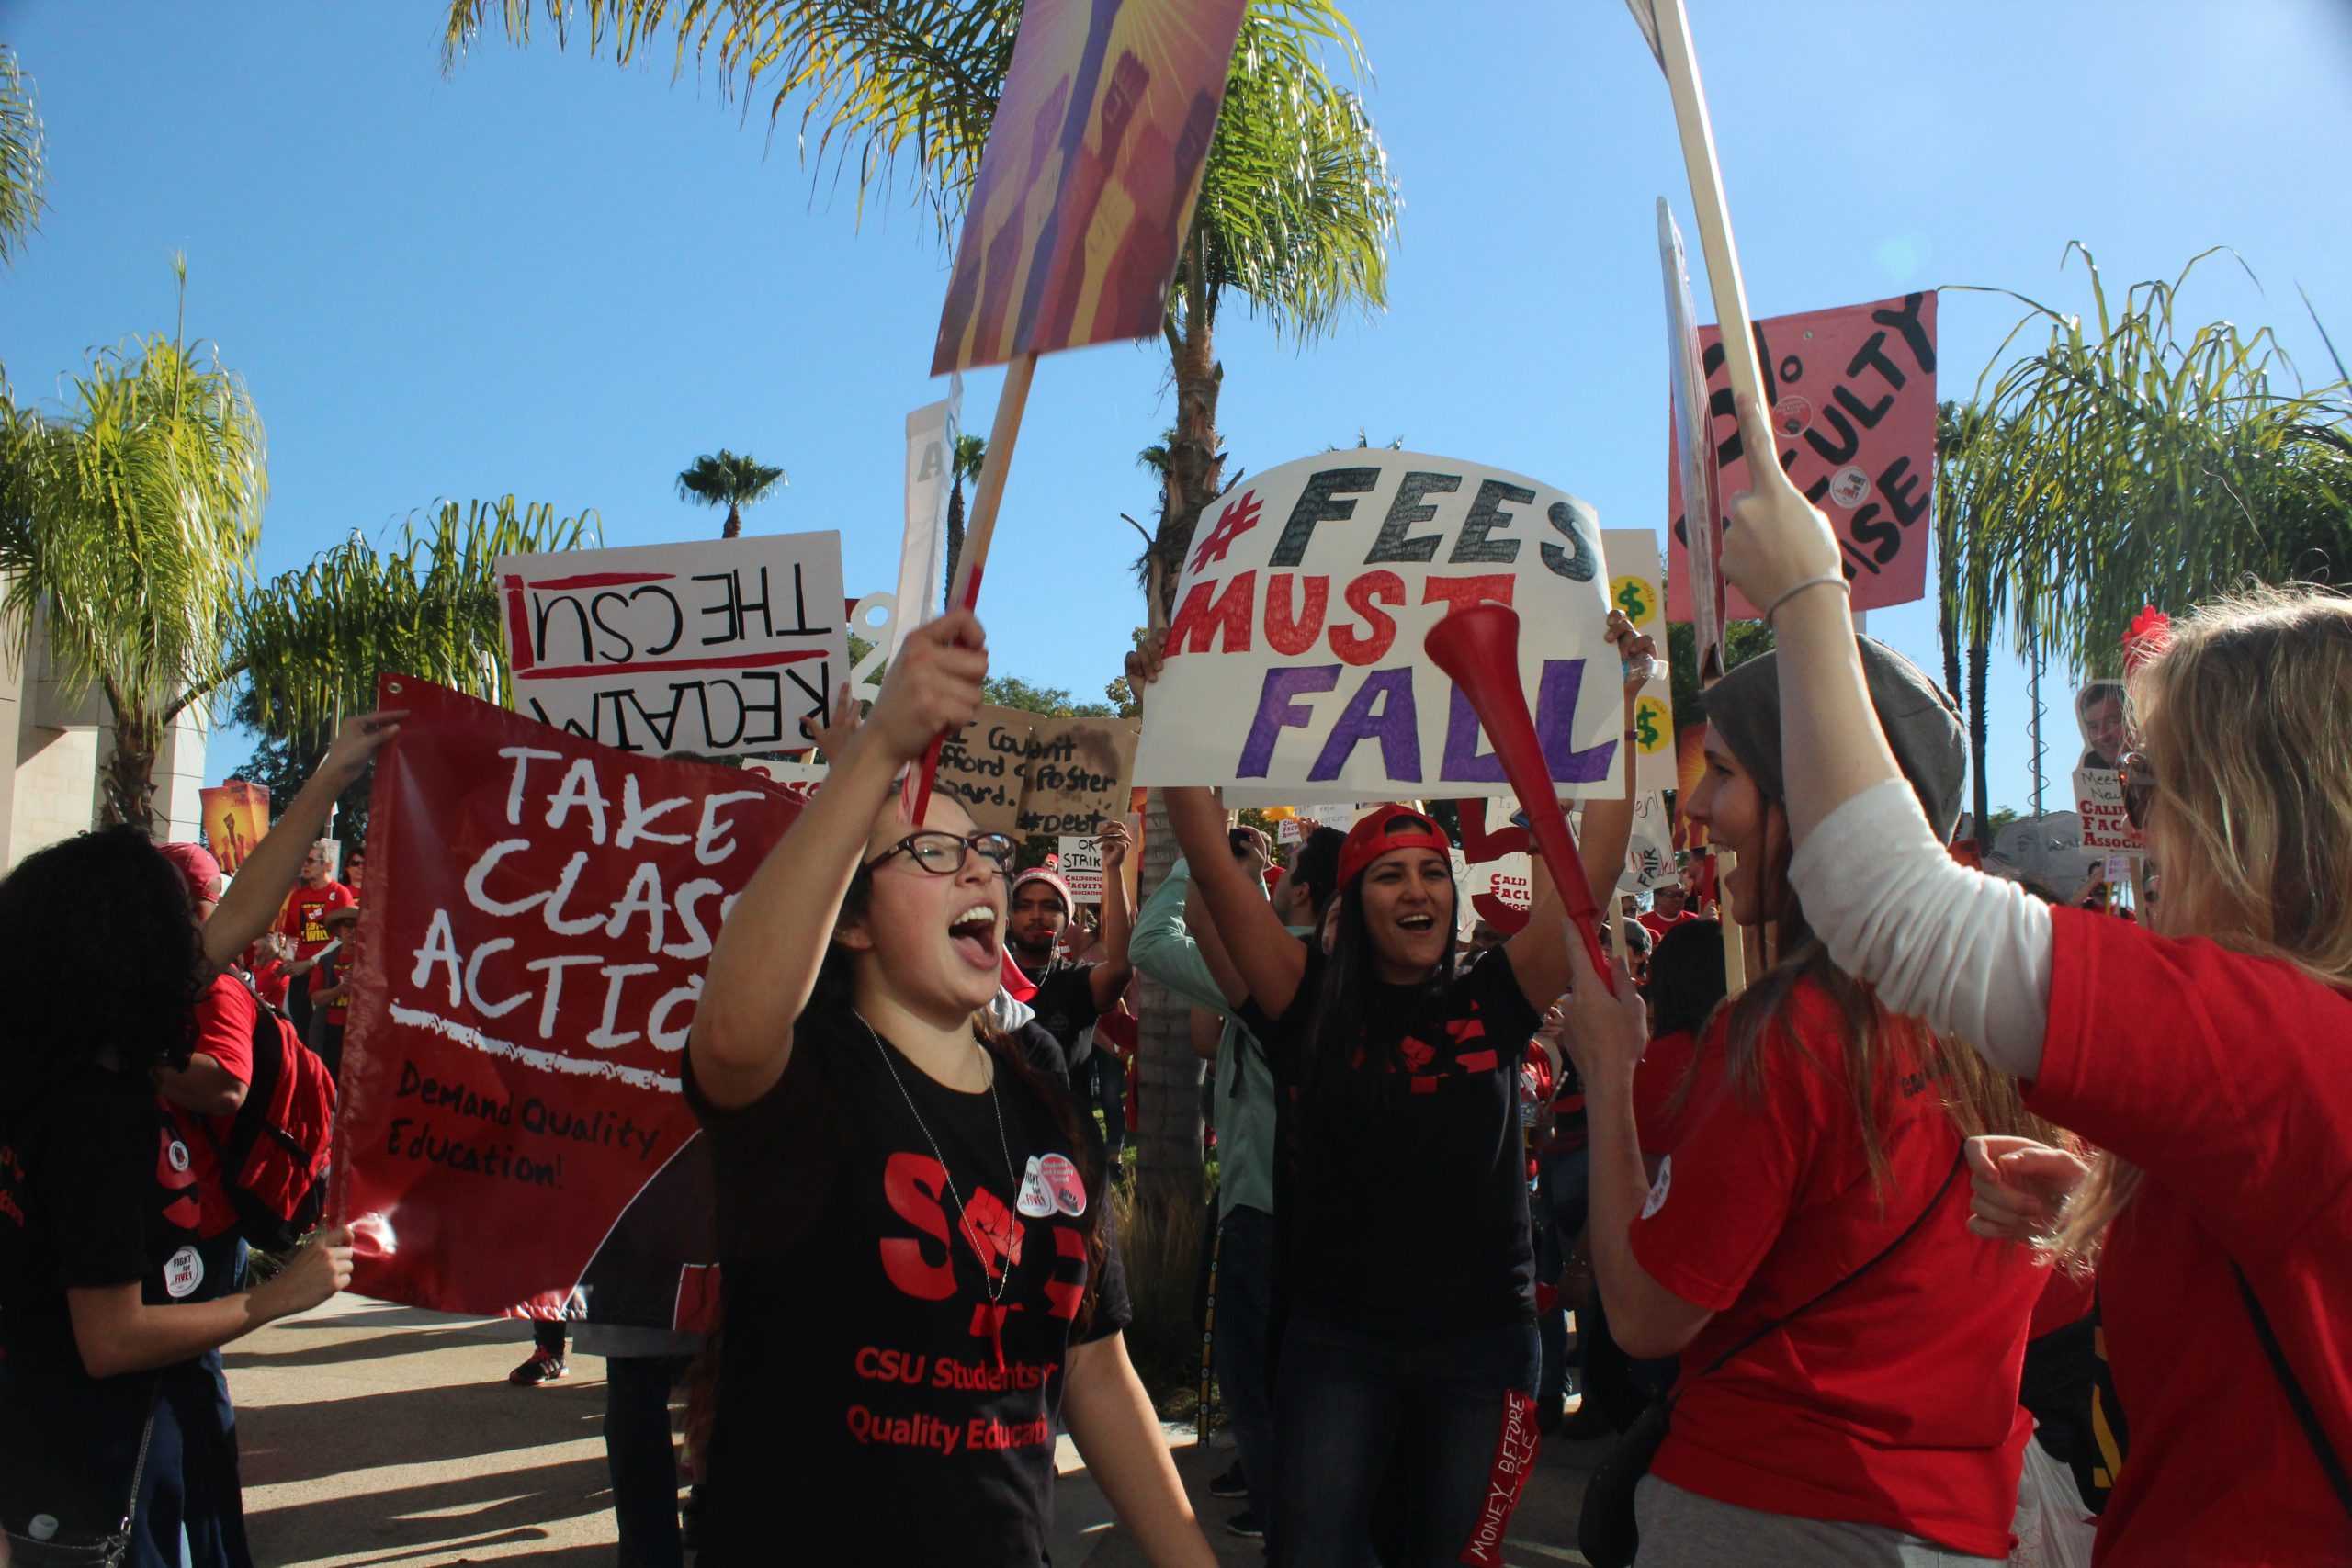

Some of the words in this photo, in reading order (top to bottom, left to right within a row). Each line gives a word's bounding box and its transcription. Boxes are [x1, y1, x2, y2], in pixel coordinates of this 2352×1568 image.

[691, 562, 832, 645] THE
[528, 661, 830, 750] RECLAIM
[1236, 659, 1618, 783] FALL
[497, 746, 766, 866] TAKE
[1064, 853, 1102, 868] STRIK
[1079, 840, 1096, 852] OR
[1637, 847, 1658, 887] FAIR
[464, 838, 742, 961] CLAS
[396, 1060, 512, 1128] Demand
[520, 1101, 661, 1161] Quality
[387, 1118, 566, 1190] Education!
[173, 1254, 192, 1268] FIGHT
[854, 1345, 926, 1384] CSU
[846, 1404, 960, 1457] Quality
[1470, 1482, 1506, 1562] MONEY
[1498, 1392, 1525, 1474] BEFORE
